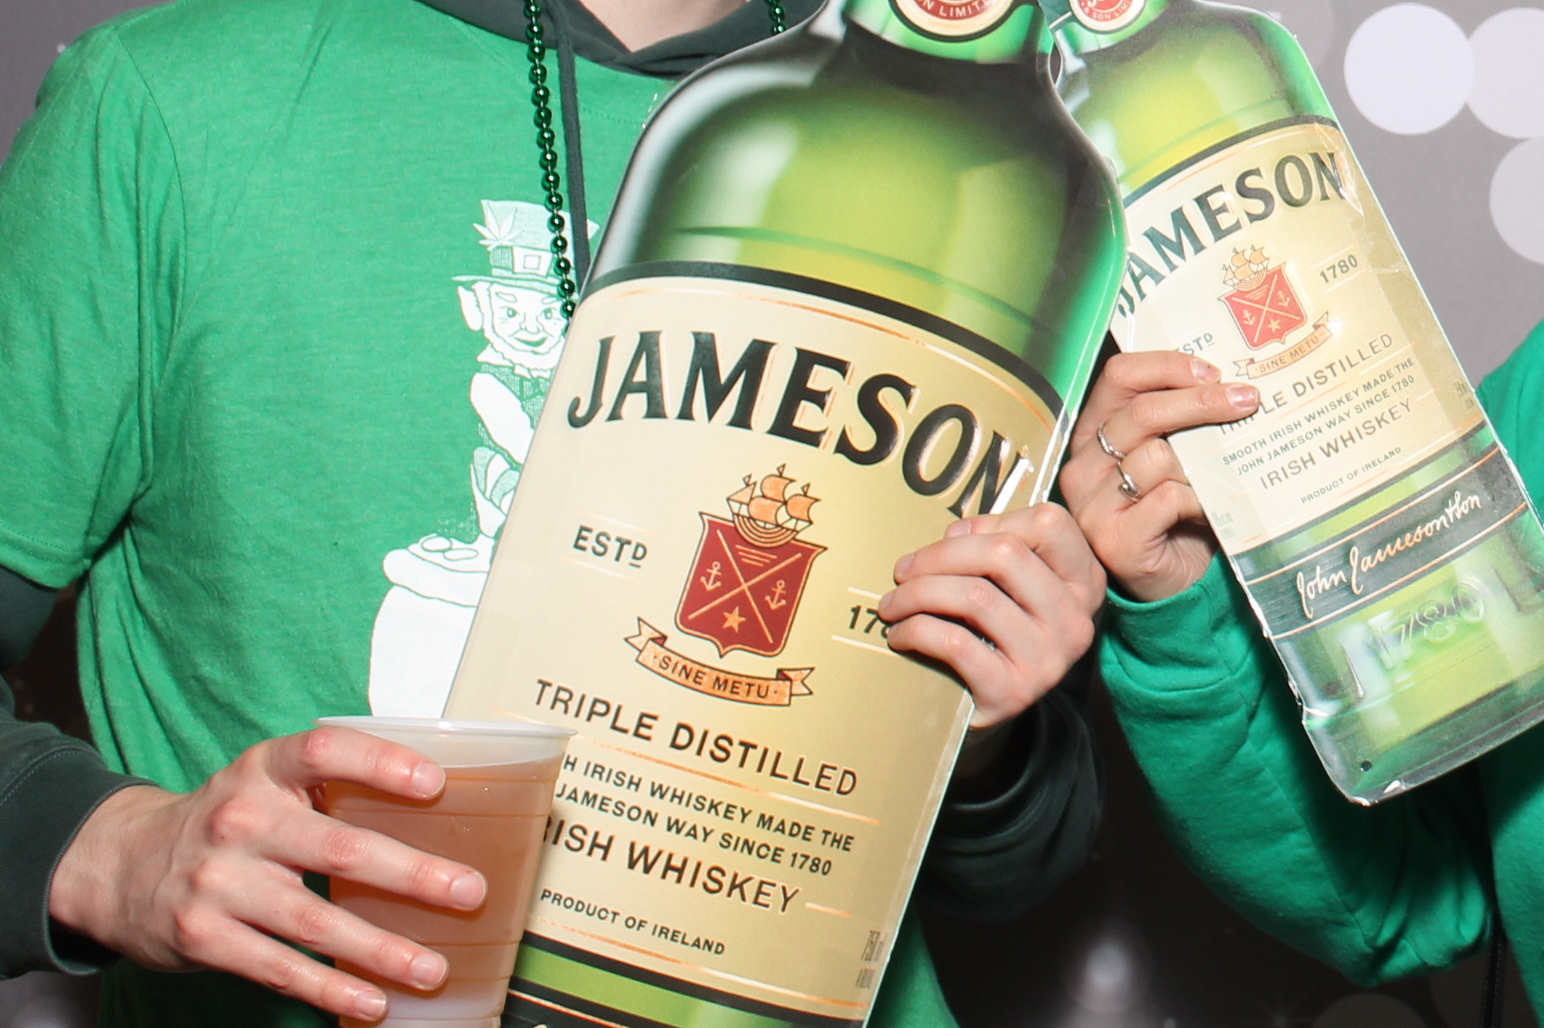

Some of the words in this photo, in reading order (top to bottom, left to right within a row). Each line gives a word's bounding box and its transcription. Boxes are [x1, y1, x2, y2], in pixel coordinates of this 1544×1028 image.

[1092, 11, 1111, 20] SON
[1319, 253, 1358, 283] 1780
[1174, 332, 1215, 356] STD
[1259, 355, 1287, 374] SINE
[1289, 336, 1319, 359] METU
[1292, 333, 1393, 397] DISTILLED
[567, 330, 1026, 520] JAMESON
[1222, 438, 1267, 465] SMOOTH
[1269, 419, 1302, 442] IRISH
[1304, 387, 1360, 423] WHISKEY
[1362, 370, 1394, 392] MADE
[1395, 357, 1415, 374] THE
[1237, 456, 1264, 475] JOHN
[1267, 425, 1323, 460] JAMESON
[1326, 409, 1352, 429] WAY
[1354, 389, 1390, 414] SINCE
[1391, 374, 1415, 392] 1780
[1259, 451, 1316, 490] IRISH
[1319, 397, 1412, 458] WHISKEY
[1300, 477, 1345, 504] PRODUCT
[1346, 468, 1360, 480] OF
[1361, 446, 1402, 473] IRELAND
[1297, 565, 1348, 619] John
[658, 655, 706, 685] SINE
[712, 675, 770, 699] METU
[535, 678, 659, 741] TRIPLE
[669, 721, 858, 797] DISTILLED
[555, 783, 657, 827] JAMESON
[665, 819, 714, 844] WAY
[719, 833, 785, 864] SINCE
[790, 852, 832, 877] 1780
[583, 760, 642, 792] IRISH
[650, 779, 752, 824] WHISKEY
[756, 812, 815, 842] MADE
[822, 829, 855, 852] THE
[543, 815, 615, 861] ISH
[627, 839, 801, 914] WHISKEY
[540, 888, 621, 925] PRODUCT
[625, 915, 647, 932] OF
[652, 923, 725, 955] IRELAND
